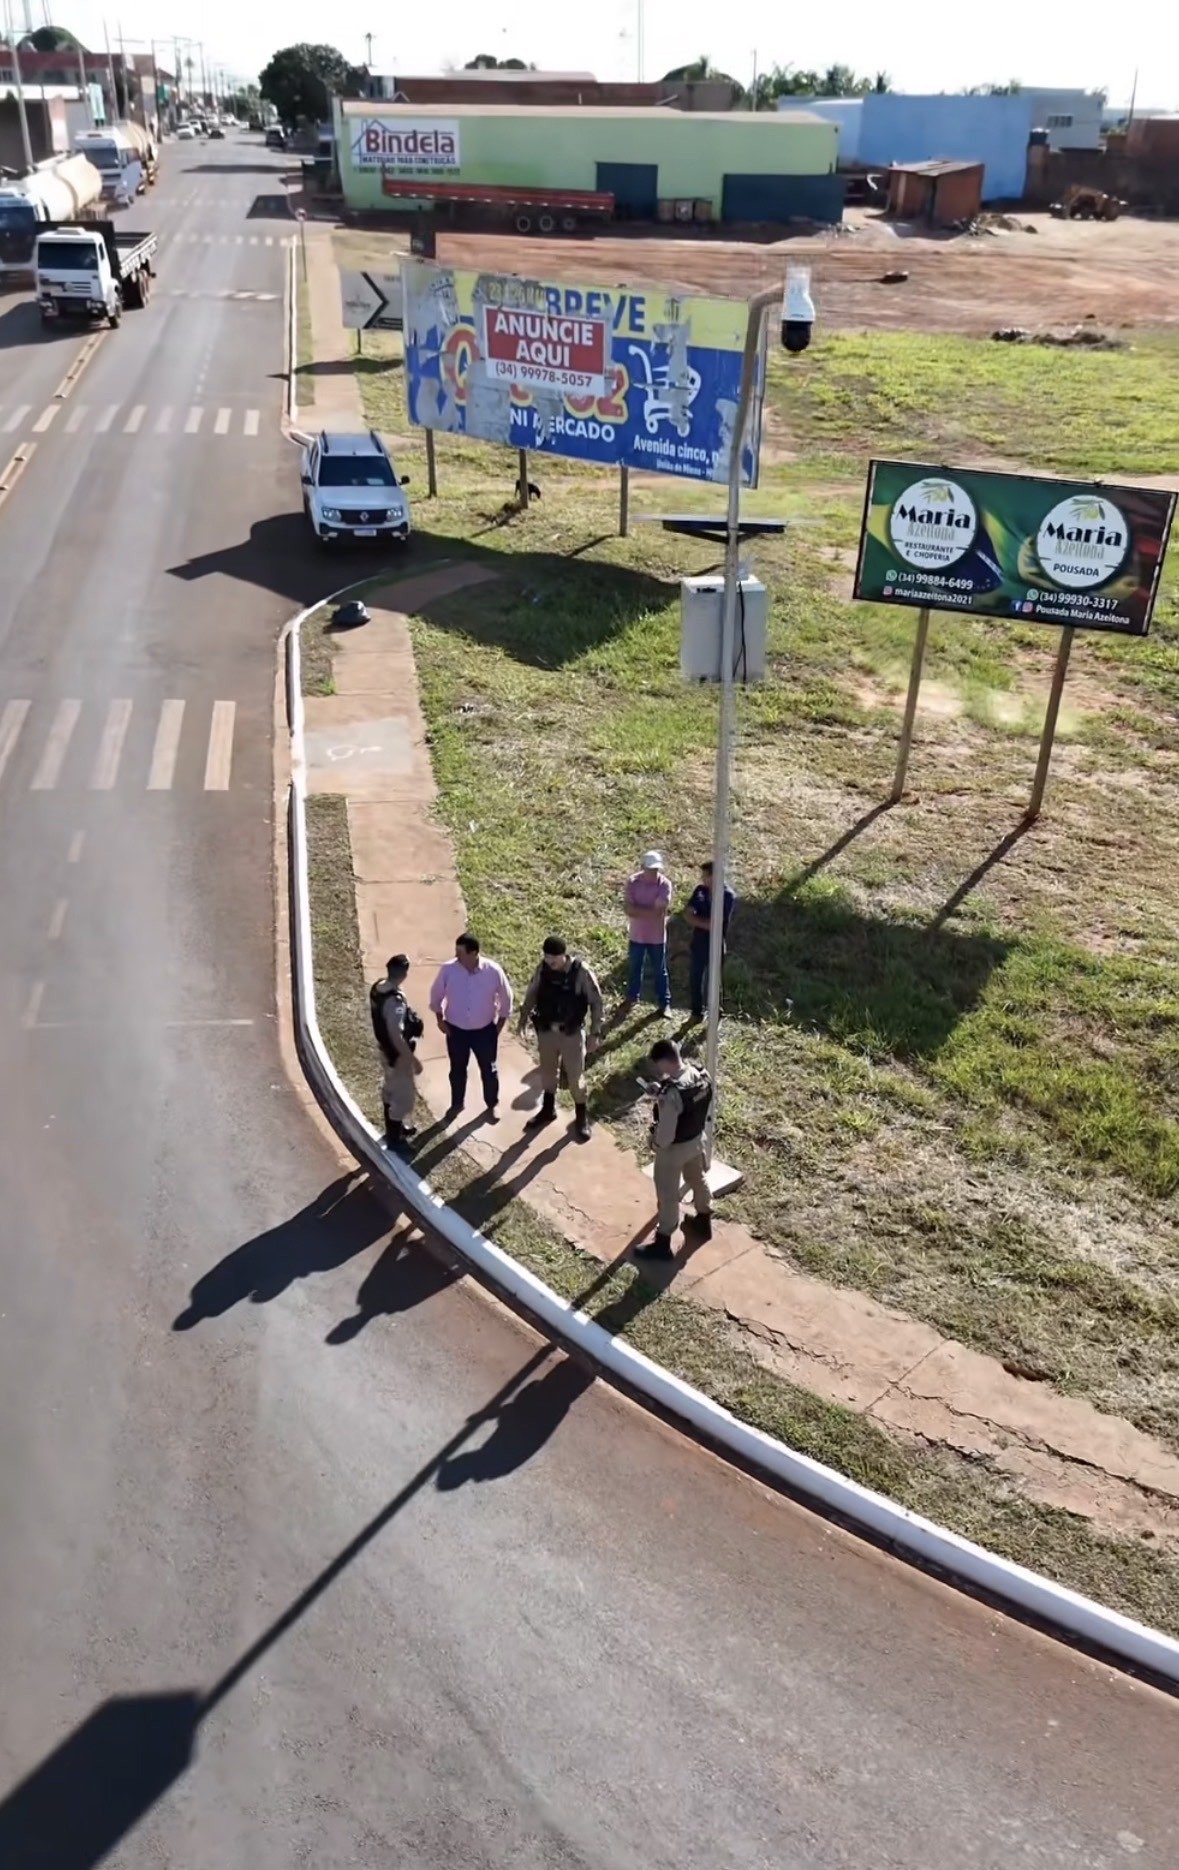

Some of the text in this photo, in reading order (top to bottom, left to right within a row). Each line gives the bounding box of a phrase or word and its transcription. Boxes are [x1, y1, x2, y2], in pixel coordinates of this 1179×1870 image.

[366, 129, 455, 154] Bindela
[494, 312, 594, 346] ANUNCIE
[516, 340, 570, 368] AQUI
[496, 361, 593, 388] (34) 99978-5057
[633, 434, 676, 457] Avenida
[896, 504, 971, 529] Maria
[907, 522, 955, 541] Azeitona
[1043, 522, 1123, 547] Maria
[905, 541, 954, 554] RESTAURANTE
[914, 551, 951, 562] CHOPERIA
[1054, 540, 1105, 560] Azeitona
[1053, 563, 1100, 577] POUSADA
[898, 572, 974, 590] (34) 99884-6499
[895, 588, 972, 605] mariaazeitona2021
[1040, 592, 1118, 611] (34) 99930-3317
[1036, 604, 1130, 625] Pousada Maria Azeitona
